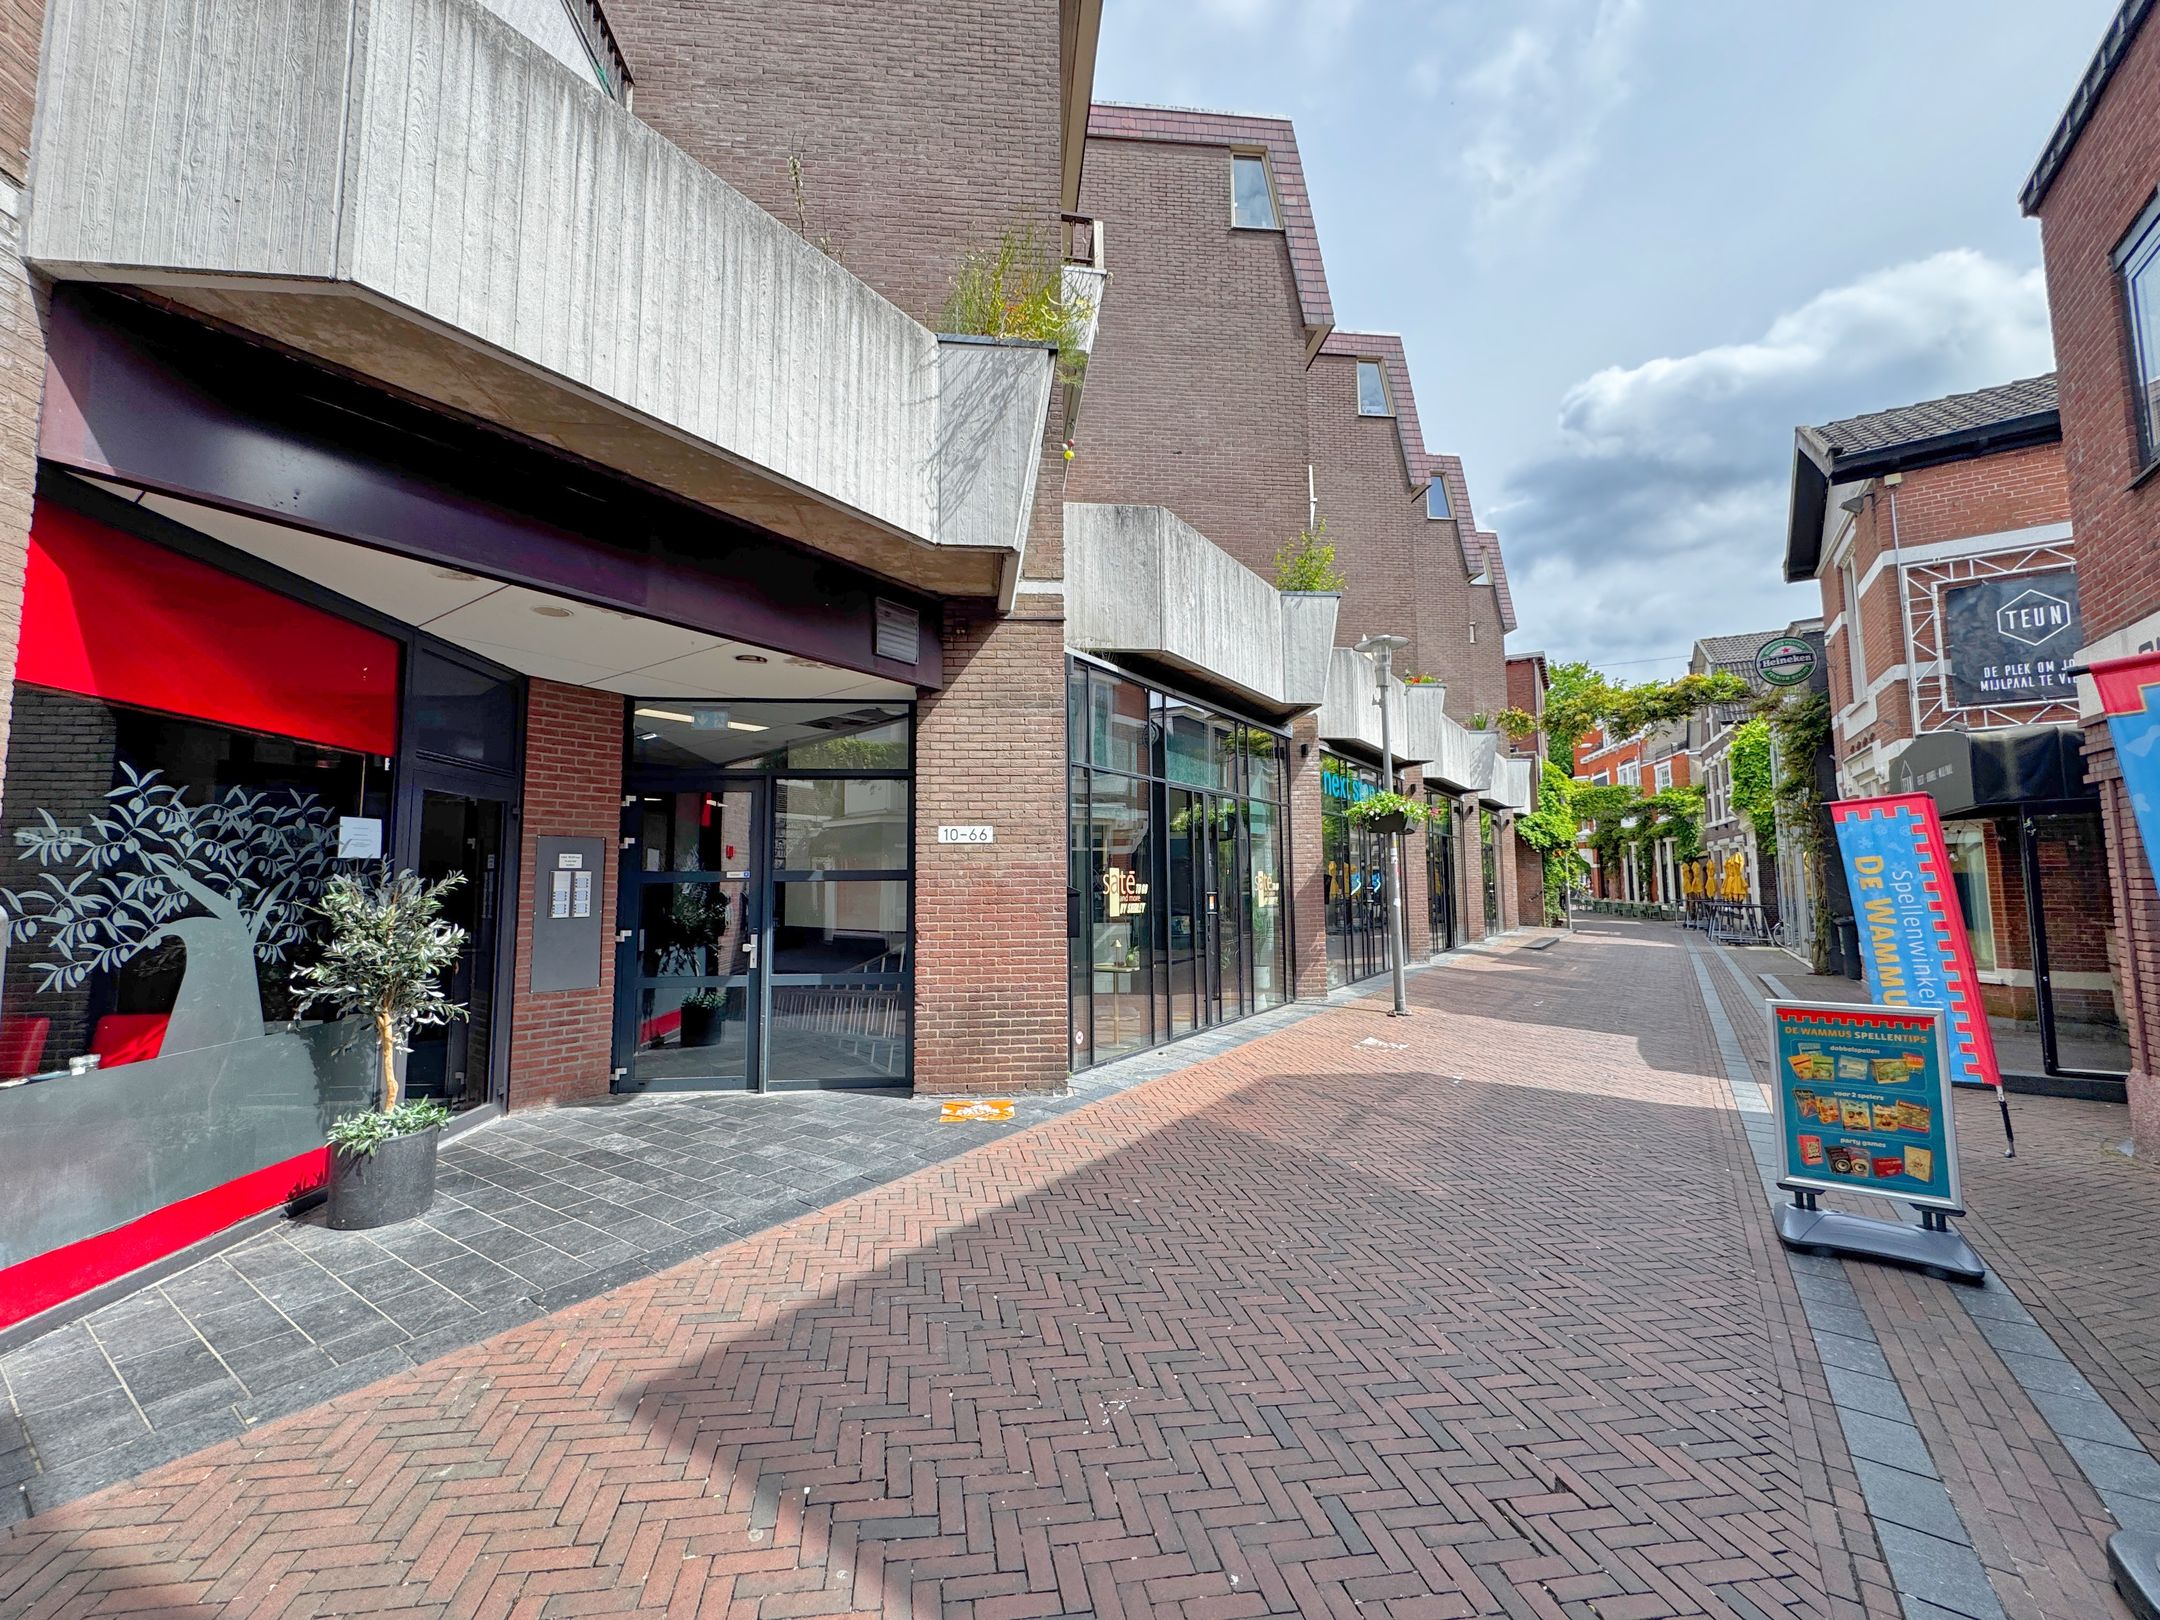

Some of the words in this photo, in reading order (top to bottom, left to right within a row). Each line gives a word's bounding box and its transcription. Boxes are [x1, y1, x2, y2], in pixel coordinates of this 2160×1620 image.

[2005, 605, 2062, 629] TEUN
[1762, 655, 1812, 667] Heineken
[1984, 666, 1999, 678] DE
[2005, 663, 2031, 676] PLEK
[2037, 661, 2055, 673] OM
[2061, 659, 2075, 671] JO
[1980, 676, 2035, 692] MIJLPAAL
[2039, 674, 2054, 686] TE
[1322, 771, 1351, 799] next
[943, 828, 988, 841] 10-66
[1854, 855, 1884, 891] DE
[1889, 870, 1944, 1004] Spellenwinkel
[1864, 897, 1909, 1006] WAMMU
[1784, 1026, 1799, 1035] DE
[1801, 1027, 1852, 1039] WAMMUS
[1854, 1031, 1929, 1044] SPELLENTIPS
[1829, 1045, 1880, 1055] dobbelspellen
[1833, 1090, 1851, 1098] voor
[1840, 1137, 1861, 1147] party
[1862, 1140, 1887, 1149] games
